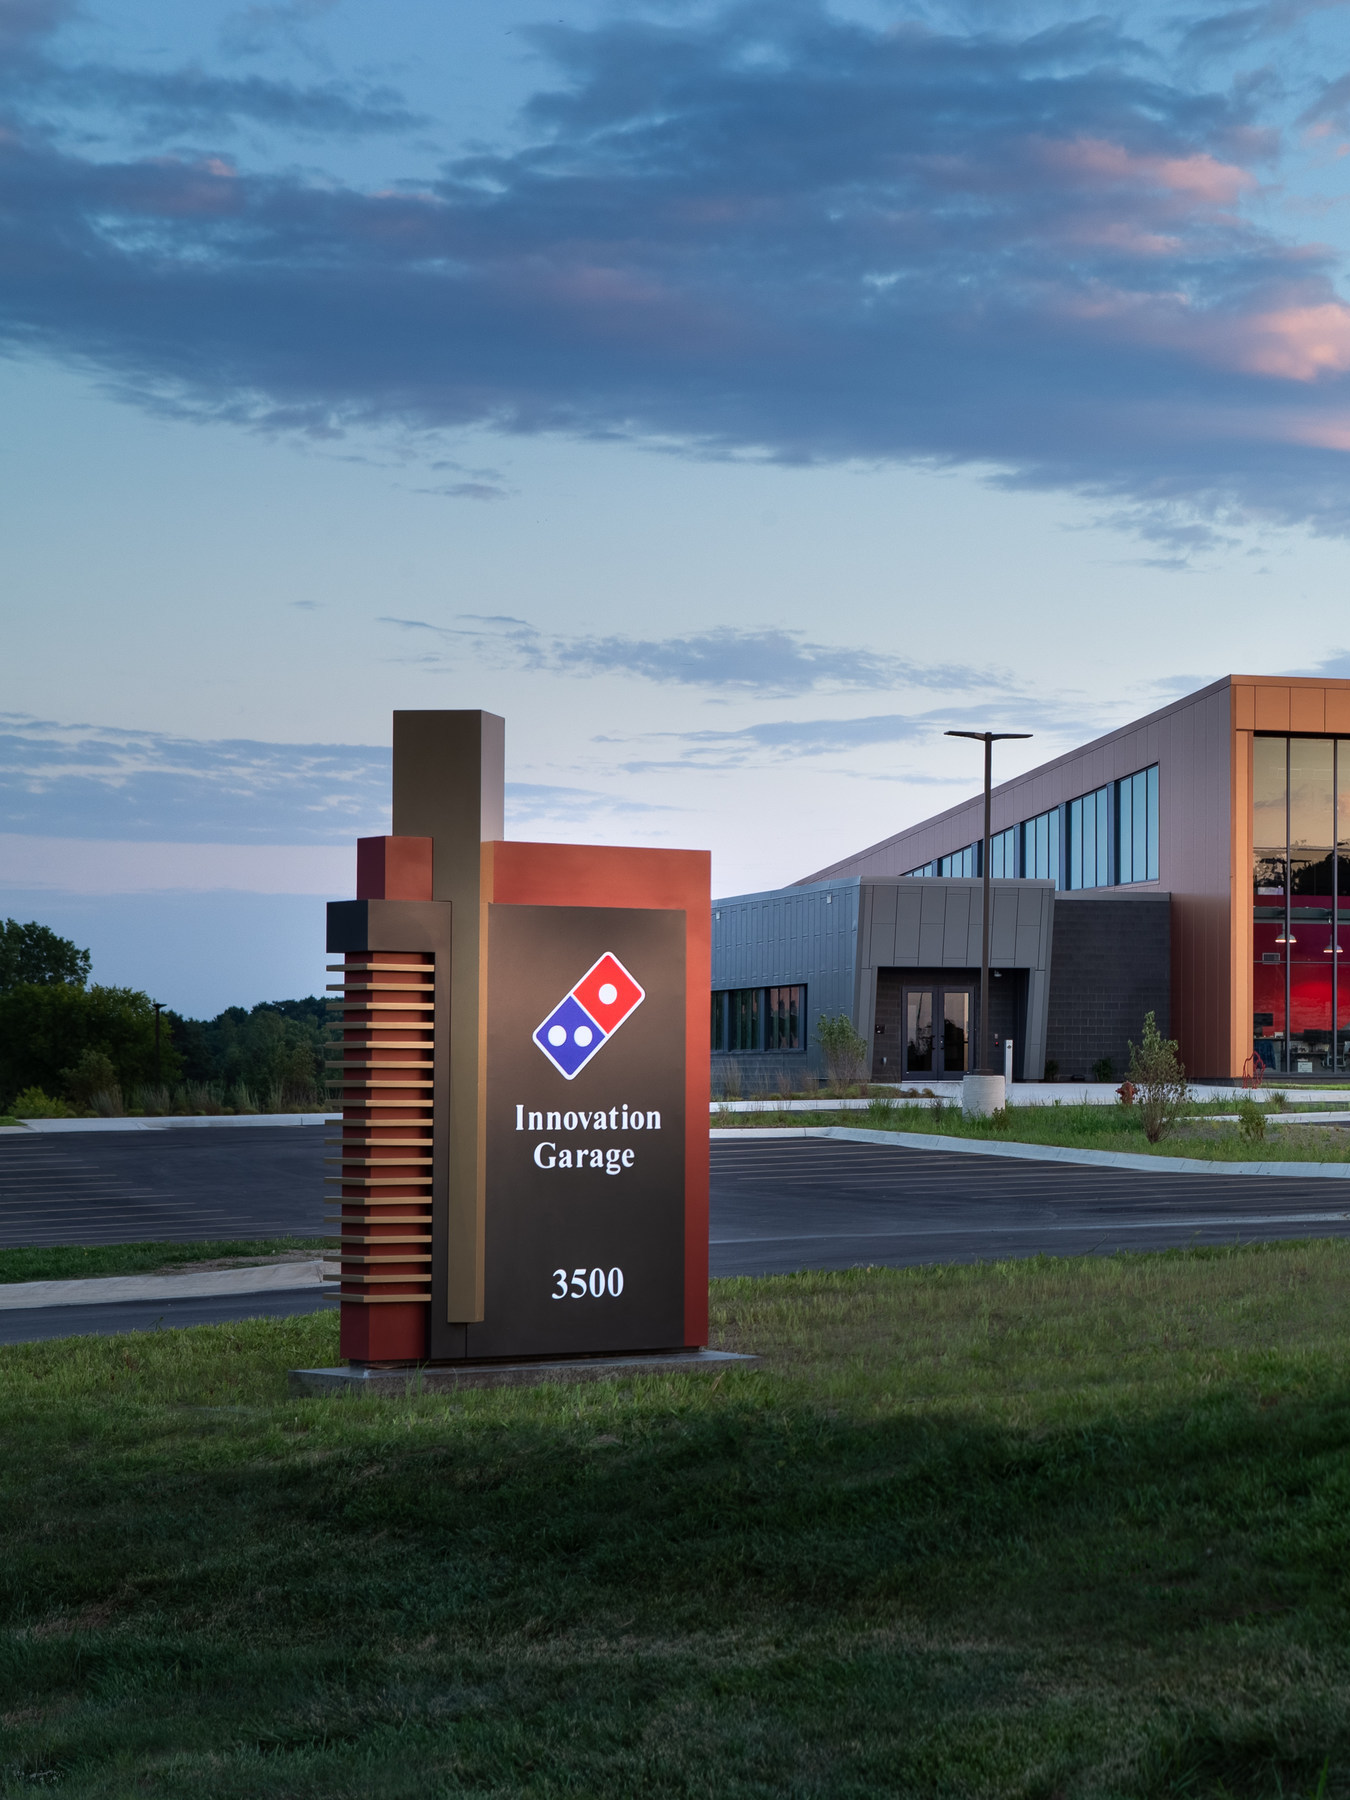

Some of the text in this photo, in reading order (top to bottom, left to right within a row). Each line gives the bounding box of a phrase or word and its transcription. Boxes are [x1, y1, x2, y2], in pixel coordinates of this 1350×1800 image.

[515, 1103, 662, 1131] Innovation
[533, 1141, 635, 1175] Garage
[551, 1266, 624, 1300] 3500
